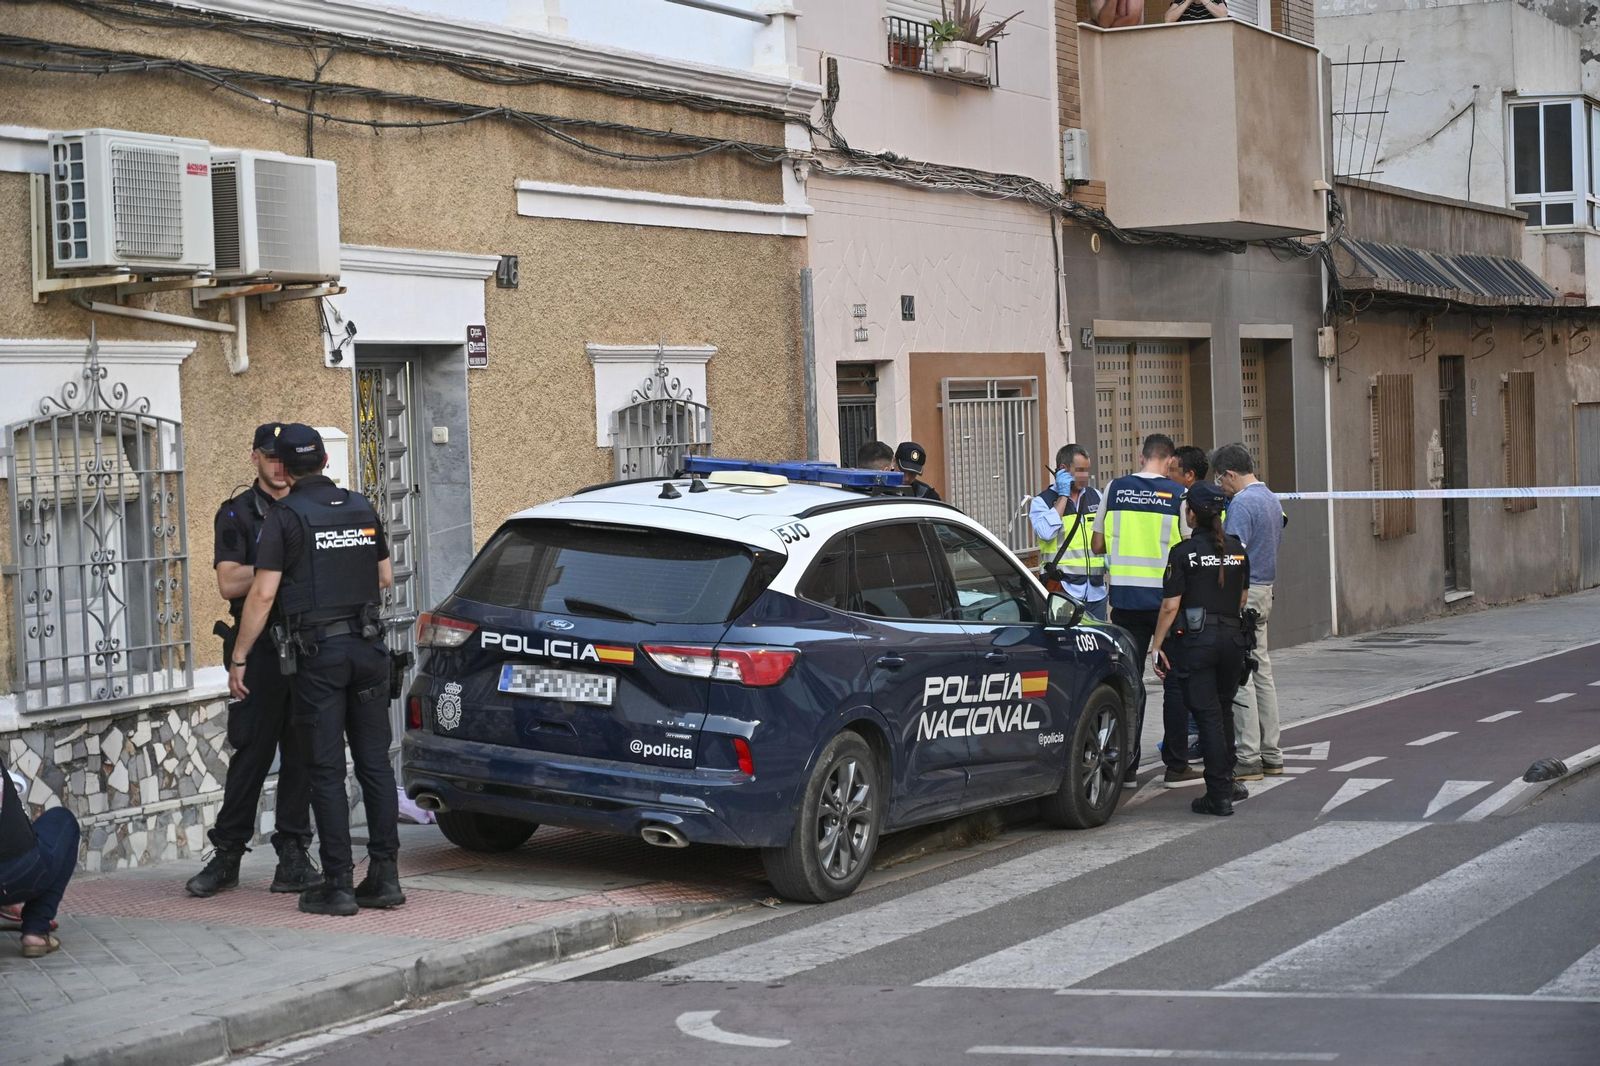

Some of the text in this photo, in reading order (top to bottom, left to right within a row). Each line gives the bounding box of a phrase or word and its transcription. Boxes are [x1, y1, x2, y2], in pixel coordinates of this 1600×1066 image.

[499, 256, 518, 285] 46
[903, 296, 915, 318] 44
[1115, 496, 1172, 507] NACIONAL
[1116, 489, 1159, 498] POLICIA
[315, 528, 365, 541] POLICIA
[316, 537, 376, 550] NACIONAL
[1080, 634, 1099, 652] 091
[916, 703, 1040, 742] NACIONAL
[1038, 732, 1064, 747] @policia
[629, 739, 693, 759] @policia
